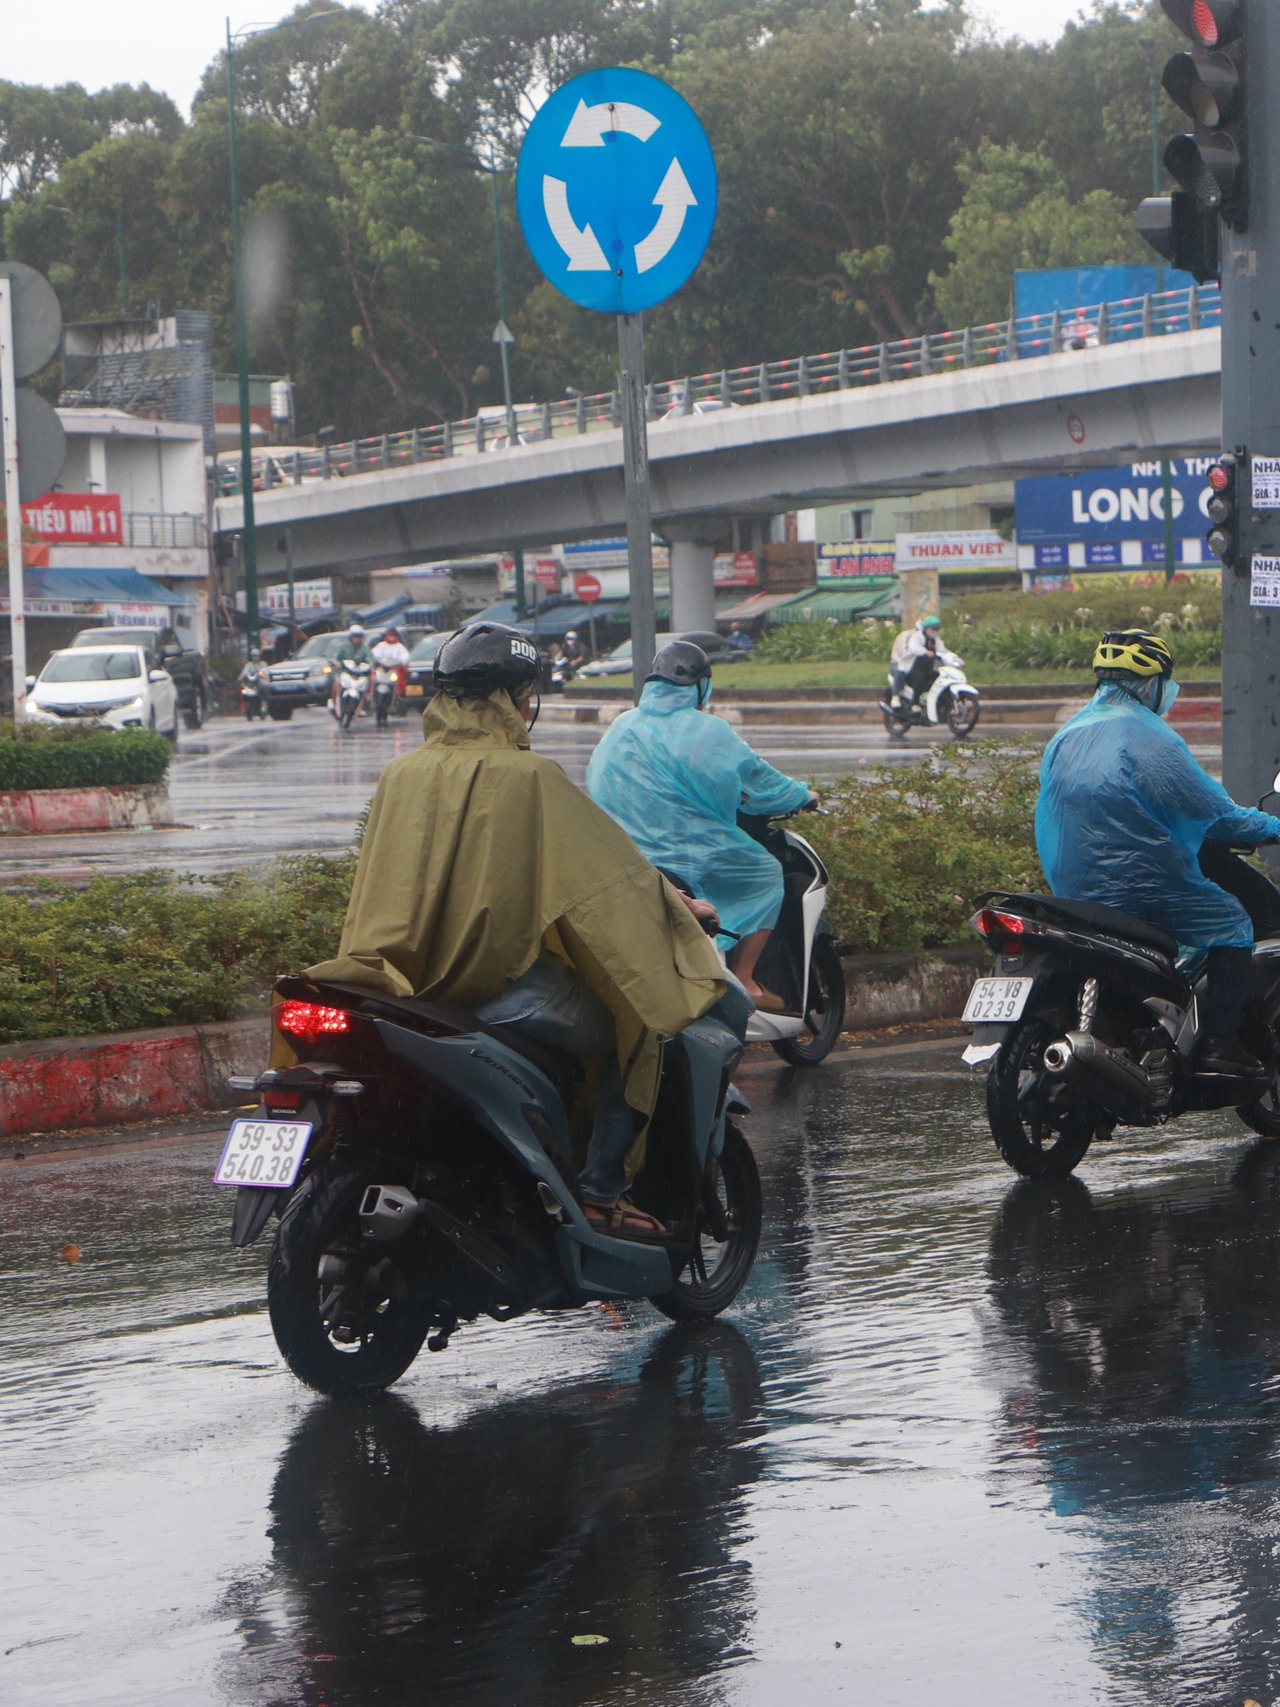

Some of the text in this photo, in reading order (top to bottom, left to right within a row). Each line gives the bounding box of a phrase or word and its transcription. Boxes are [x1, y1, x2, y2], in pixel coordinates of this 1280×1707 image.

[1254, 459, 1280, 473] NHÀ
[1274, 488, 1279, 499] 3
[1072, 486, 1184, 523] LONG
[26, 502, 117, 533] TIẾU MÌ 11
[909, 542, 963, 558] THUẬN
[969, 539, 1004, 556] VIỆT
[832, 556, 859, 576] LAN
[861, 555, 892, 575] ANH
[1254, 558, 1280, 572] NHÀ
[1273, 587, 1278, 598] 3
[511, 640, 537, 660] POC
[980, 981, 1022, 998] 54-V8
[972, 1001, 1016, 1018] 0239
[239, 1124, 298, 1152] 59-S3
[223, 1153, 294, 1182] 540.38
